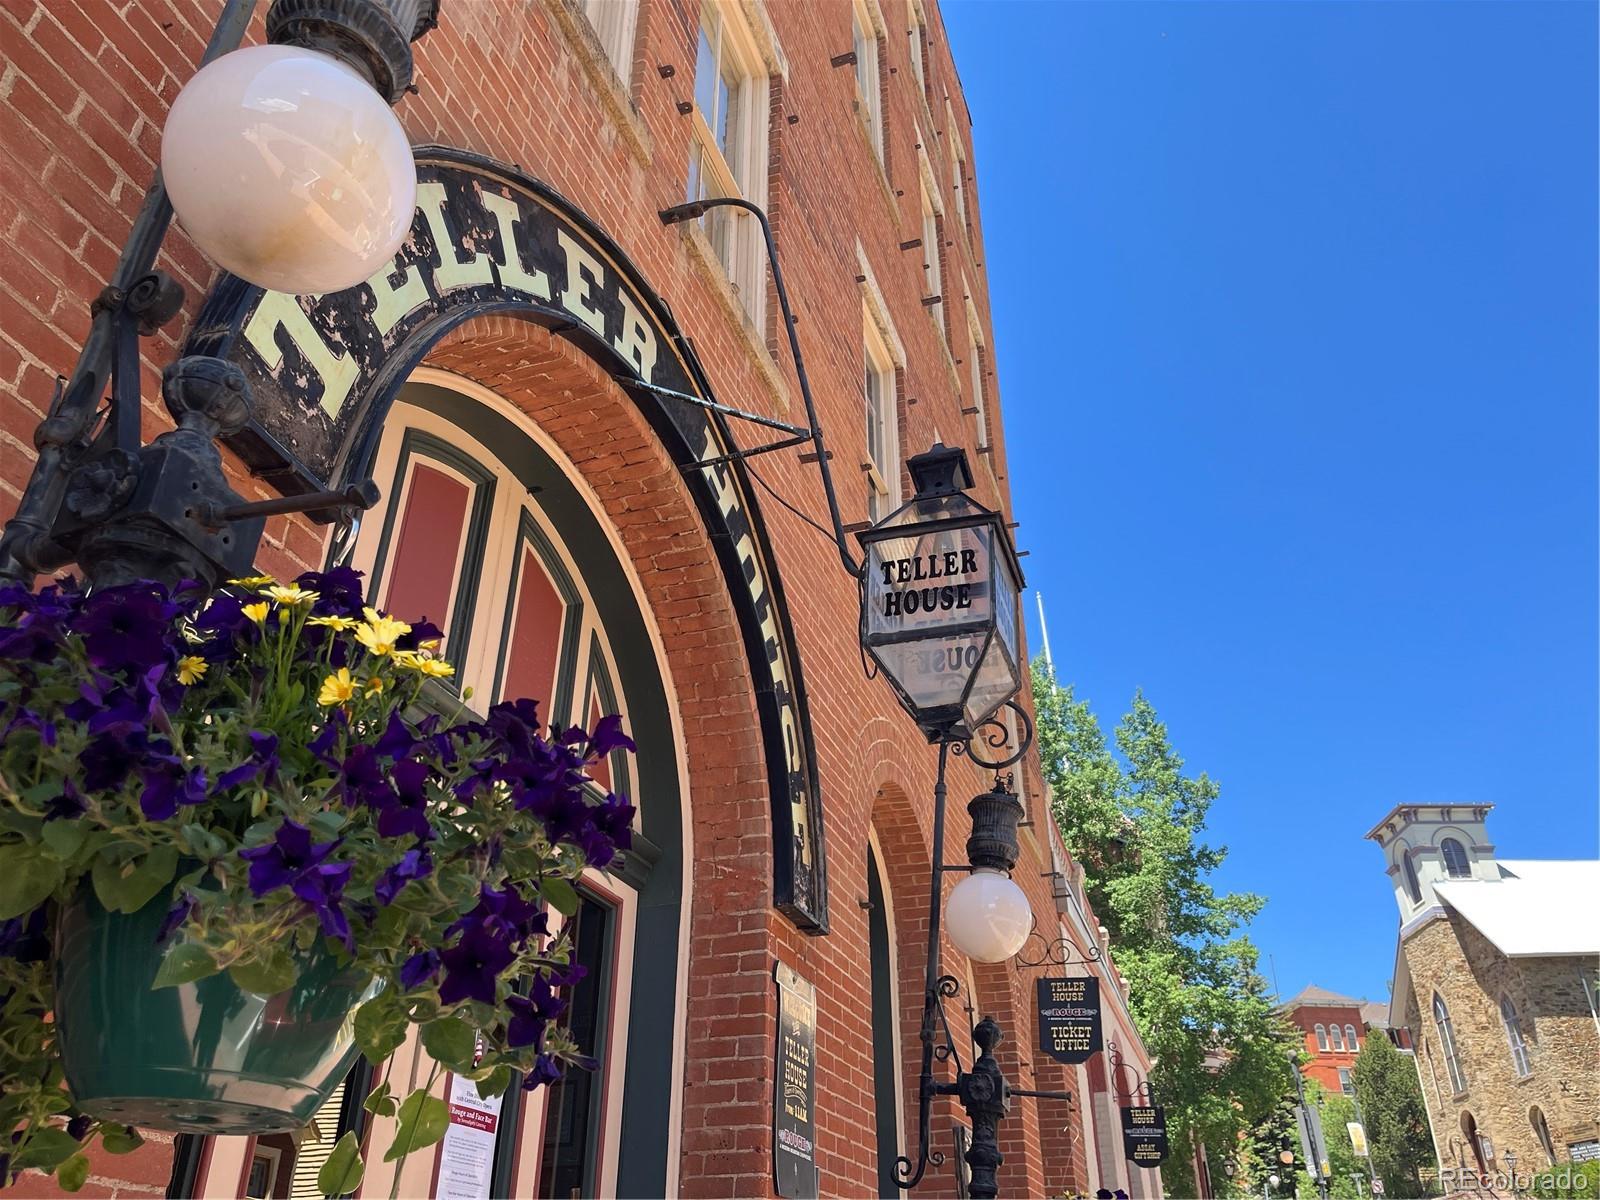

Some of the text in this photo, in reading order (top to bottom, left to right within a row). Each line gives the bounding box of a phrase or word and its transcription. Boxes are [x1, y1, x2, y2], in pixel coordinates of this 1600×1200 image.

[880, 549, 978, 585] TELLER
[884, 584, 972, 617] HOUSE
[1050, 982, 1086, 992] TELLER
[1052, 992, 1084, 1001] HOUSE
[1053, 1008, 1086, 1017] ROUGE
[1051, 1026, 1092, 1038] TICKET
[785, 1035, 810, 1068] TELLER
[1054, 1039, 1090, 1051] OFFICE
[784, 1059, 807, 1090] HOUSE
[451, 1106, 493, 1124] Rouge and Face Bar
[1130, 1109, 1156, 1117] TELLER
[784, 1128, 806, 1152] ROUGE
